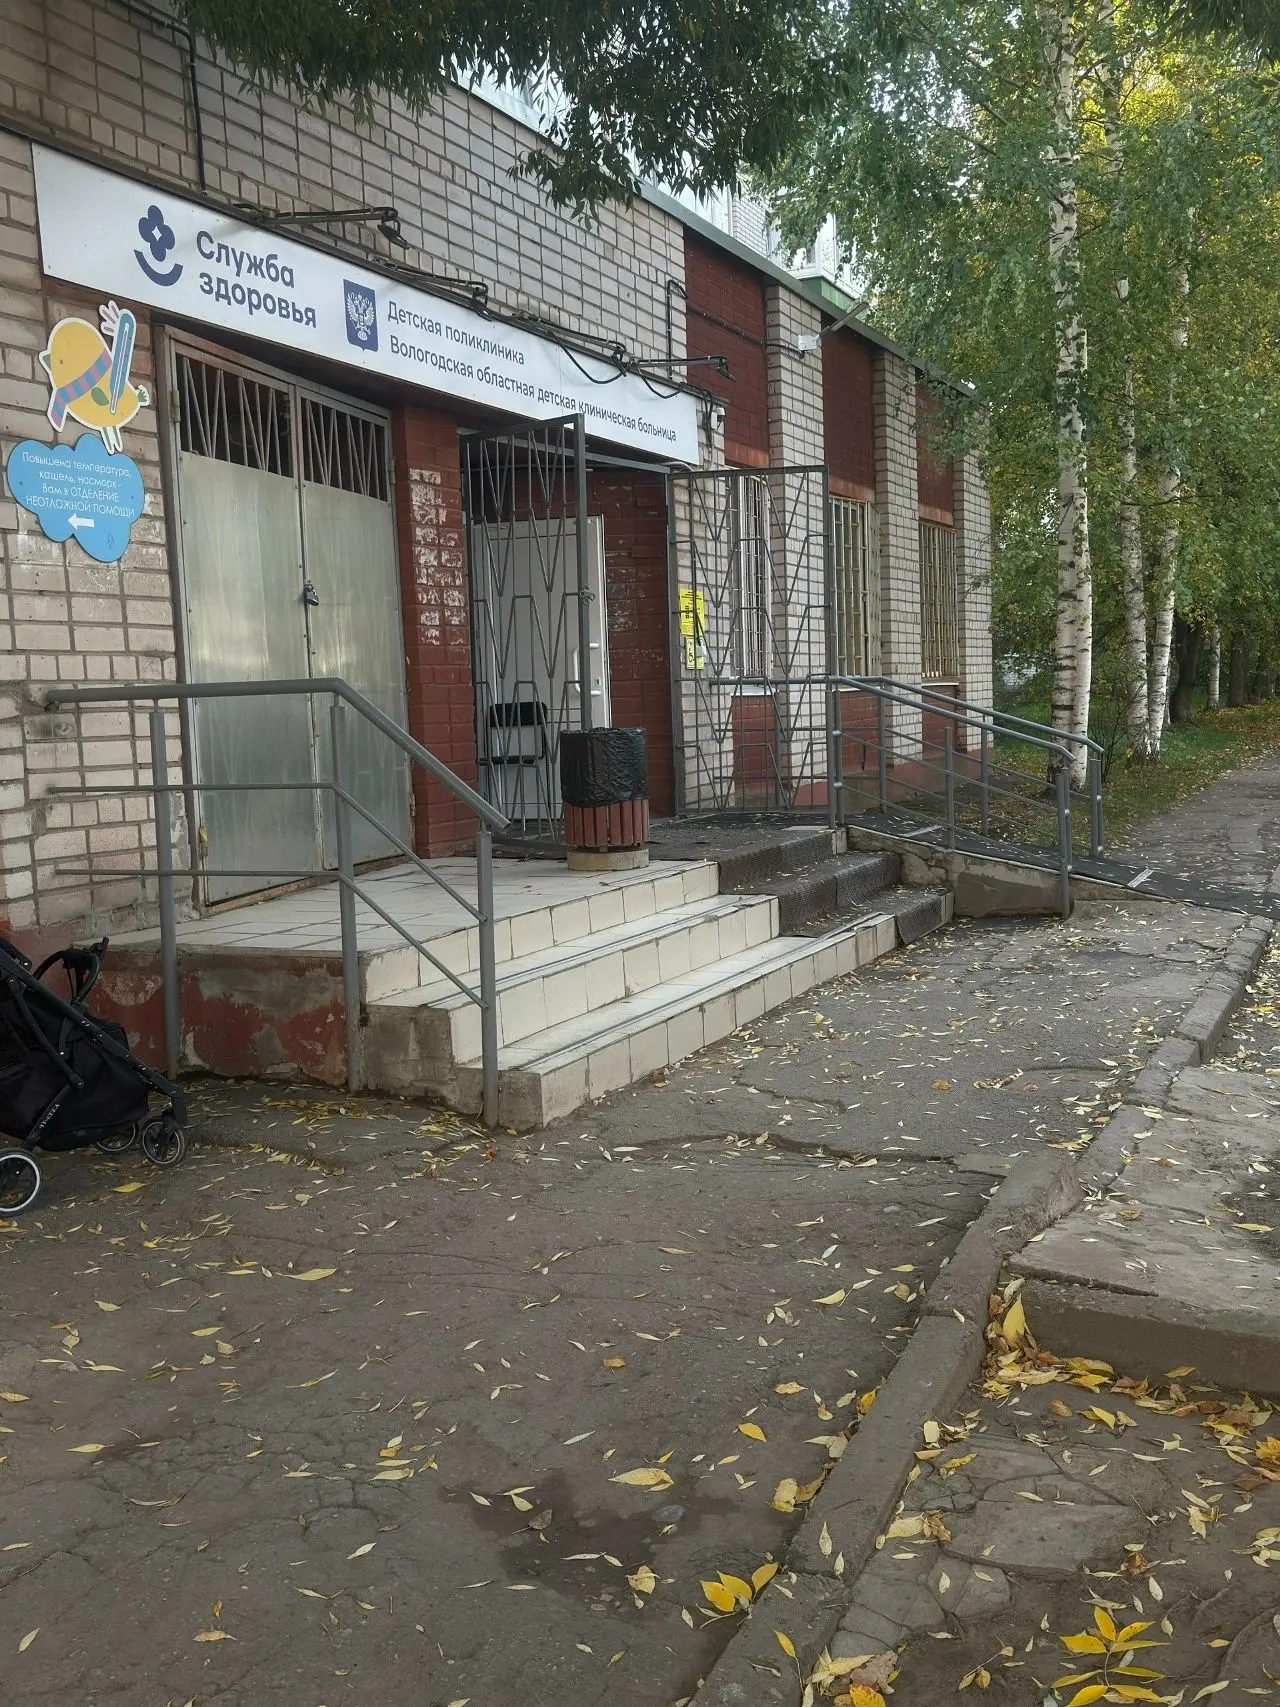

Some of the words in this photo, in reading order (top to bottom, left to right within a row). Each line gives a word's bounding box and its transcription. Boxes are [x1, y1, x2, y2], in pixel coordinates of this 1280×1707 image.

[197, 230, 294, 288] Служба
[199, 272, 317, 329] здоровья
[388, 302, 442, 336] Детская
[445, 326, 525, 365] поликлиника
[390, 335, 474, 379] Вологодская
[477, 369, 535, 399] областная
[537, 387, 577, 411] детская
[578, 400, 636, 430] клиническая
[637, 417, 677, 442] больница
[22, 451, 72, 468] Повышена
[73, 461, 132, 478] температура,
[39, 470, 76, 483] кашель,
[77, 477, 117, 488] насморк
[26, 496, 91, 512] НЕОТЛОЖНОЙ
[93, 504, 135, 518] ПОМОЩИ
[42, 483, 63, 495] Вам
[64, 488, 69, 496] в
[70, 487, 120, 502] ОТДЕЛЕНИЕ
